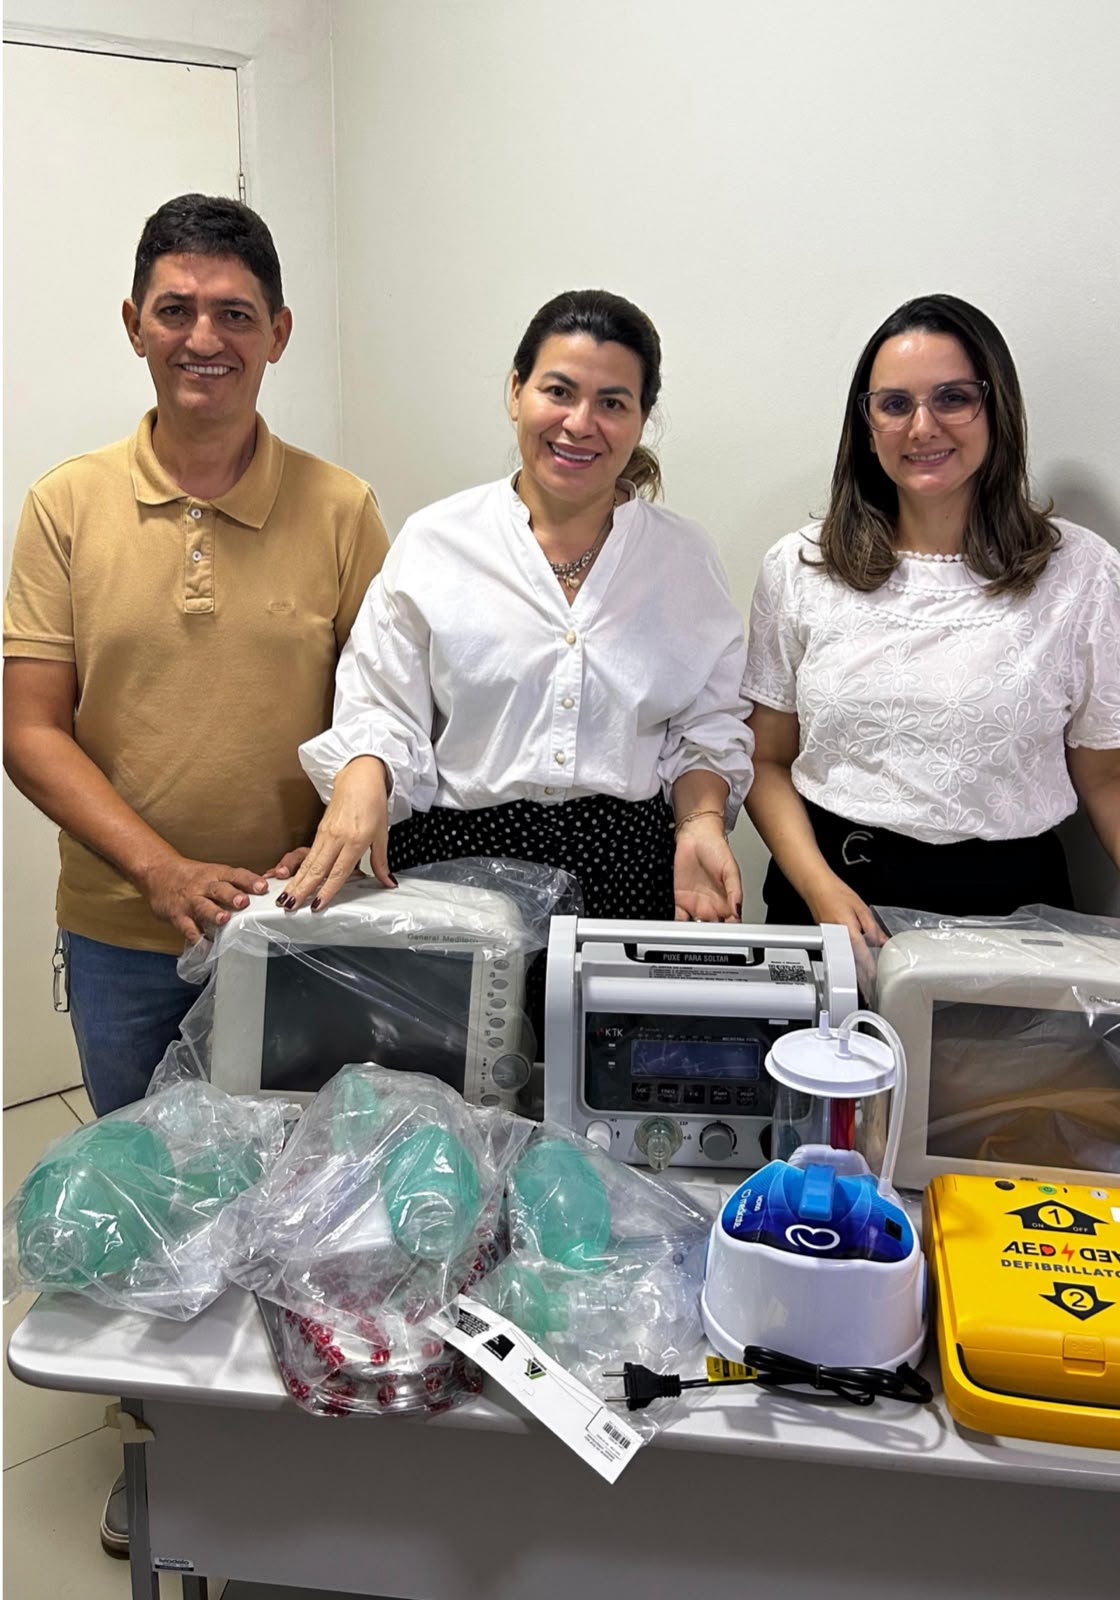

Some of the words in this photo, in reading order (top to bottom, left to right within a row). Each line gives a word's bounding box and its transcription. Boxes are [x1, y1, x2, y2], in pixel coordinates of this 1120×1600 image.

[407, 933, 440, 942] General
[662, 953, 681, 961] PUXE
[684, 954, 702, 962] PARA
[703, 954, 729, 963] SOLTAR
[605, 1028, 624, 1038] KTK
[1047, 1208, 1062, 1225] 1
[1002, 1241, 1057, 1257] AED
[1068, 1291, 1088, 1309] 2
